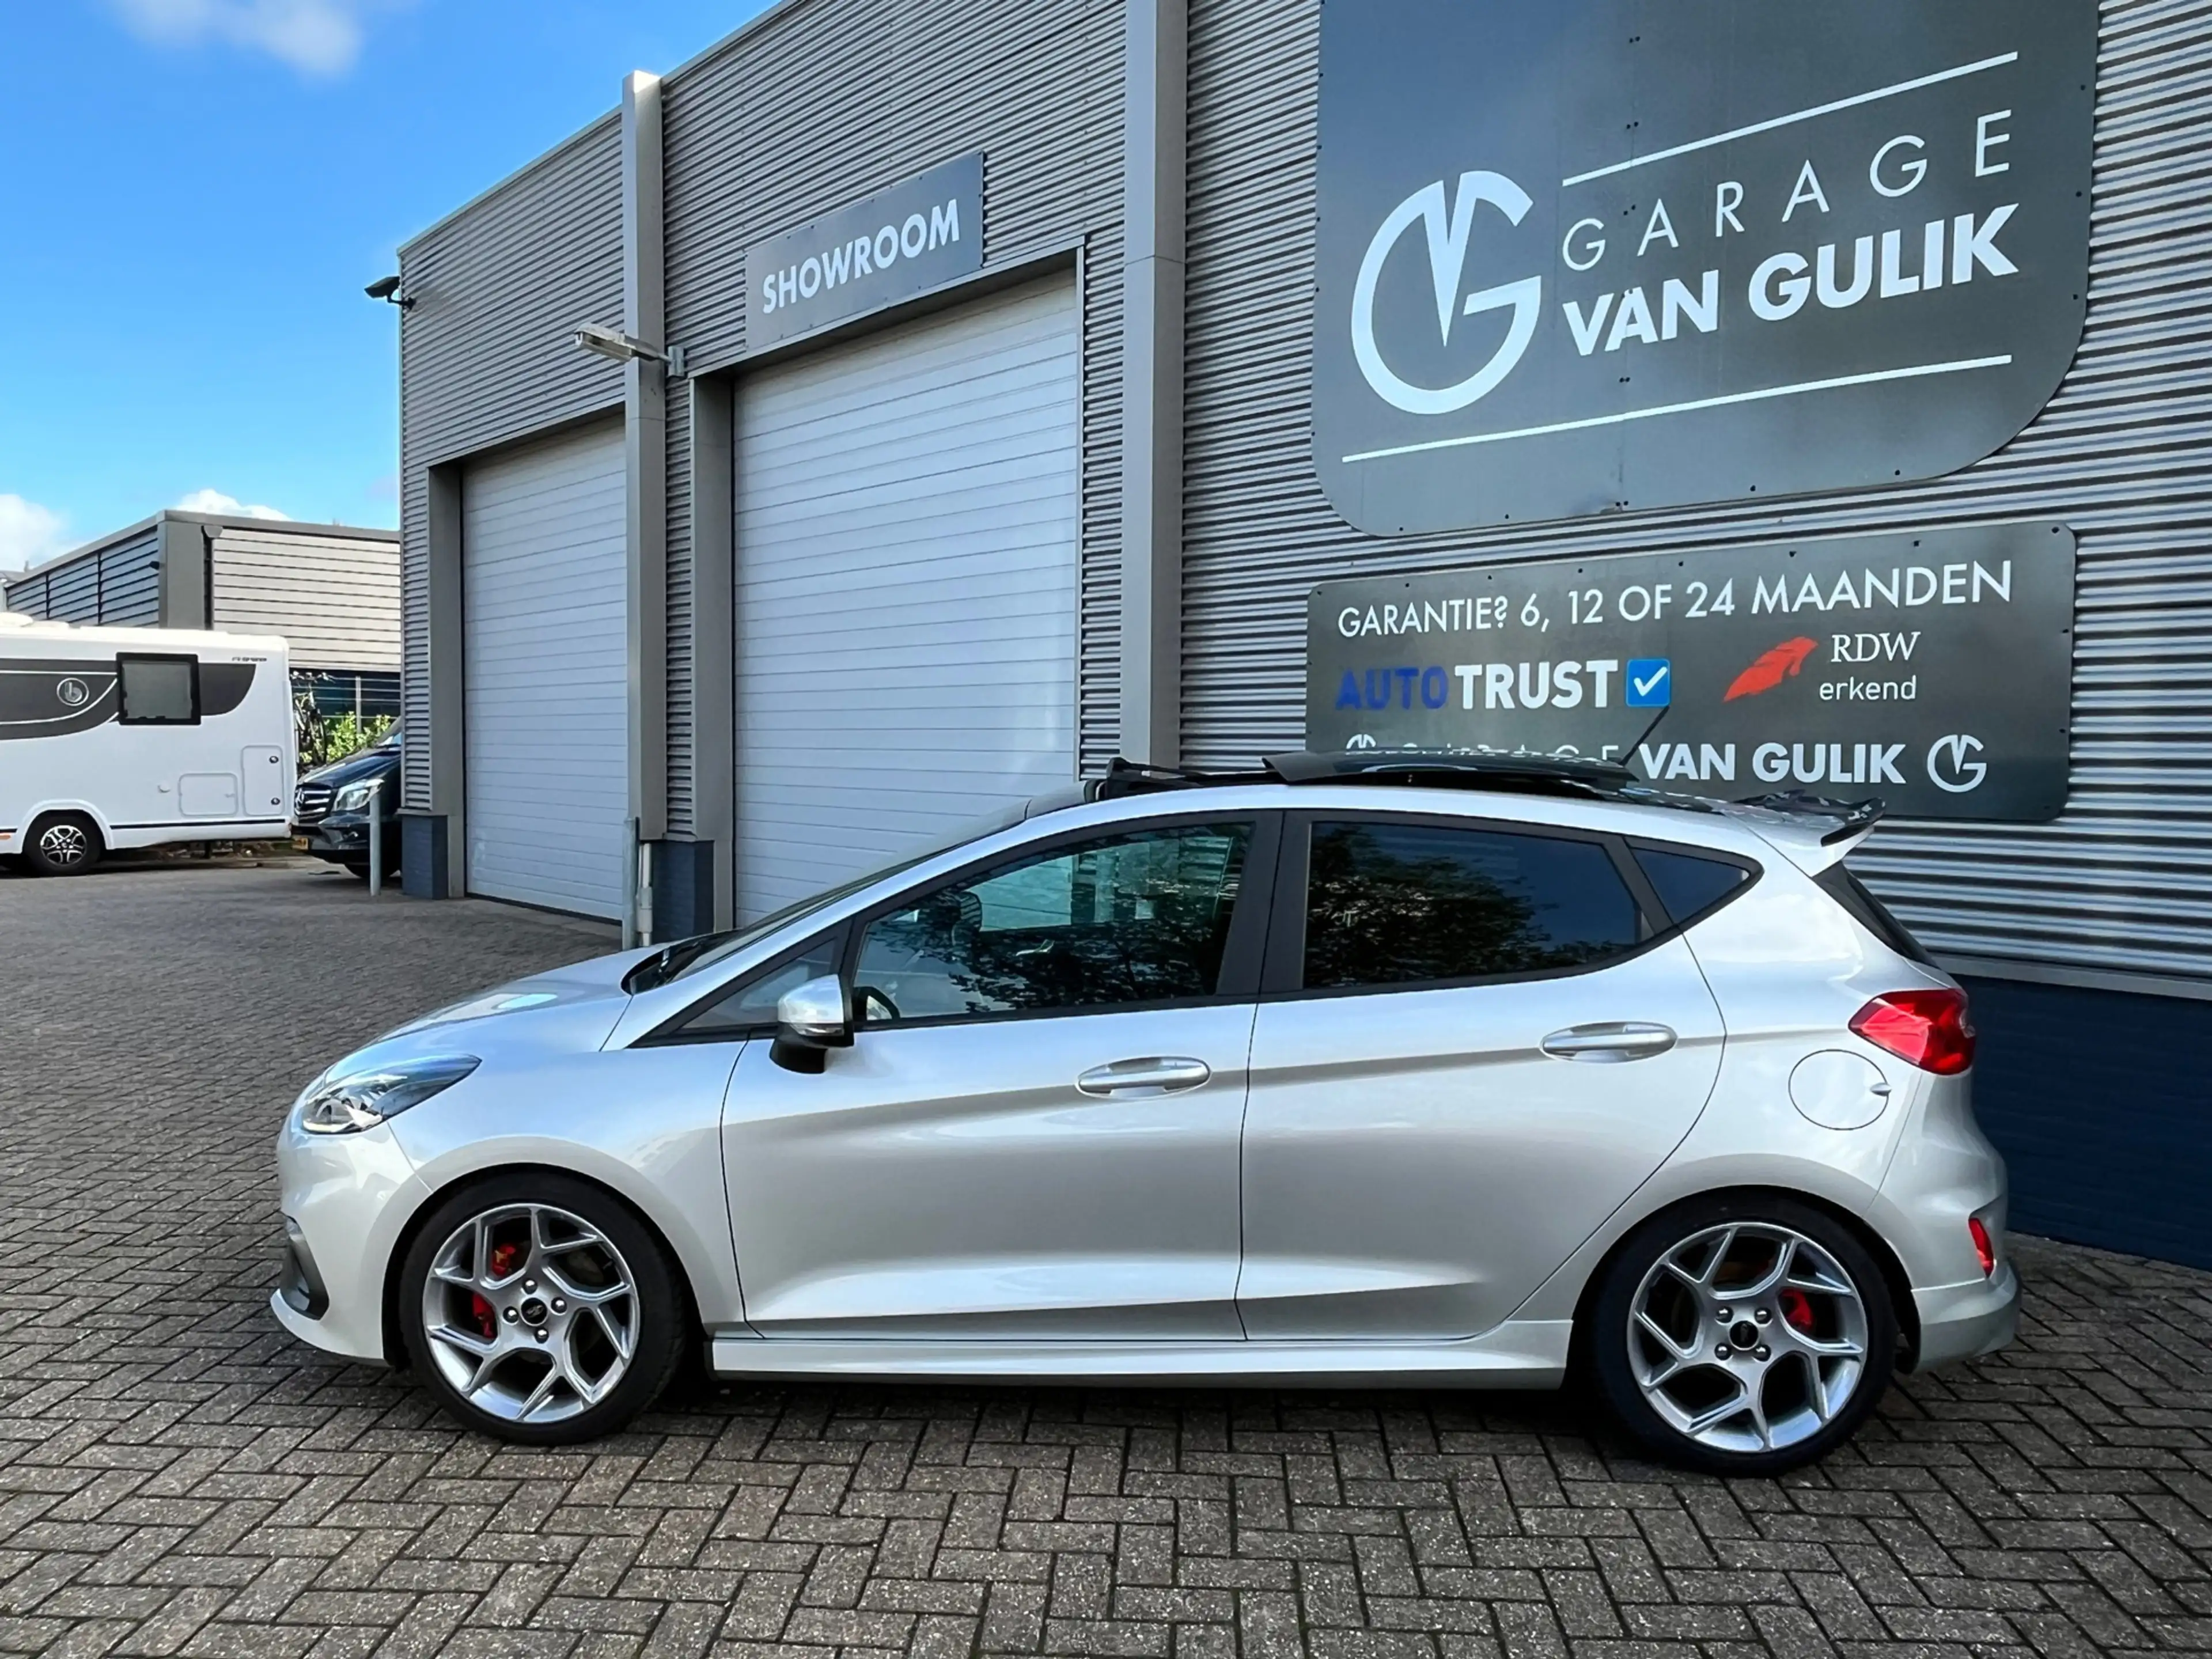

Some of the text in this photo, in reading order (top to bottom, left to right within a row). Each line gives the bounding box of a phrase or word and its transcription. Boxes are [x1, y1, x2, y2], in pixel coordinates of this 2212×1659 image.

[1562, 109, 2012, 271] GARAGE
[762, 198, 960, 314] SHOWROOM
[1562, 203, 2020, 357] VAN GULIK
[1338, 560, 2012, 638] GARANTIE? 6, 12 OF 24 MAANDEN
[1830, 630, 1922, 663] RDW
[1454, 658, 1619, 710] TRUST
[1819, 675, 1917, 701] erkend
[1638, 743, 1736, 781] VAN
[1752, 742, 1907, 785] GULIK
